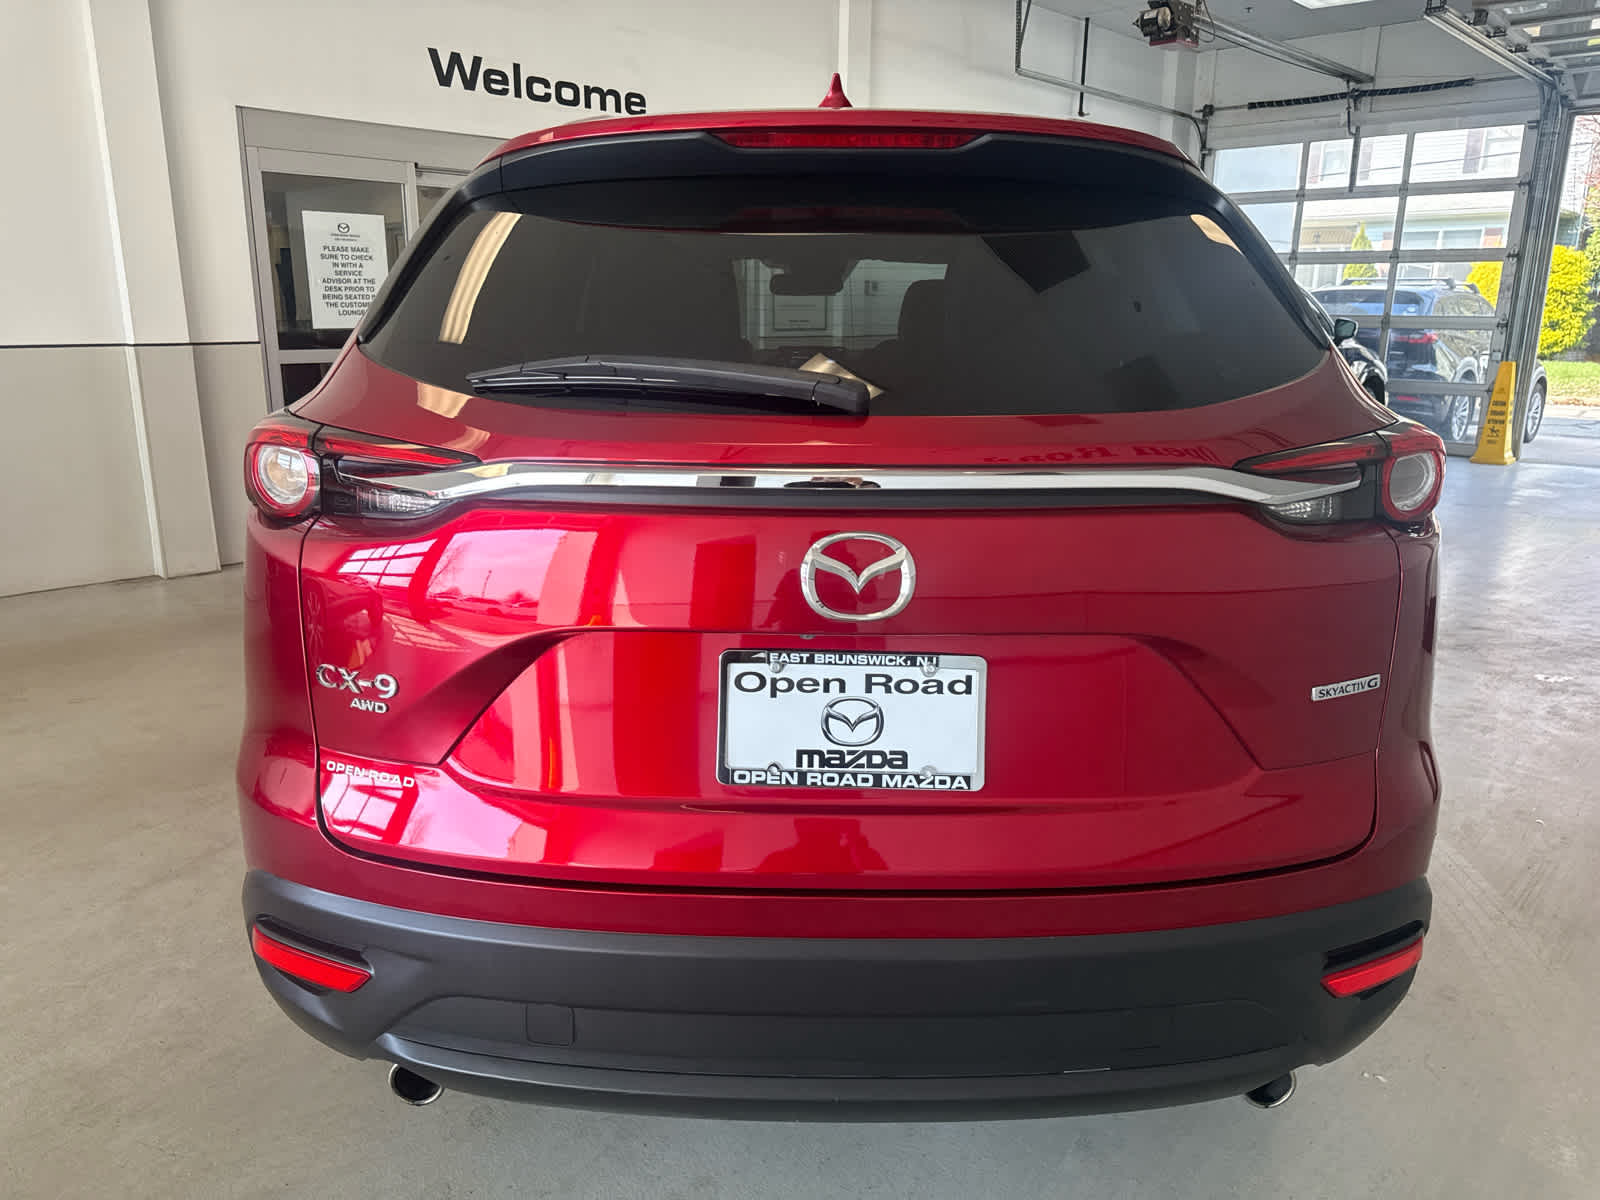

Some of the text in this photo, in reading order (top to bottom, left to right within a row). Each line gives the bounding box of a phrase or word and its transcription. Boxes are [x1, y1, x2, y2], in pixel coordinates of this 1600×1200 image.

[427, 47, 647, 116] Welcome
[769, 652, 810, 664] EAST
[814, 653, 912, 667] BRUNSWICK,
[315, 663, 399, 699] CX-9
[734, 671, 973, 698] Open Road
[350, 697, 389, 714] AWD
[796, 749, 908, 769] mazda
[326, 760, 415, 788] OPEN ROAD
[734, 770, 969, 790] OPEN ROAD MAZDA
